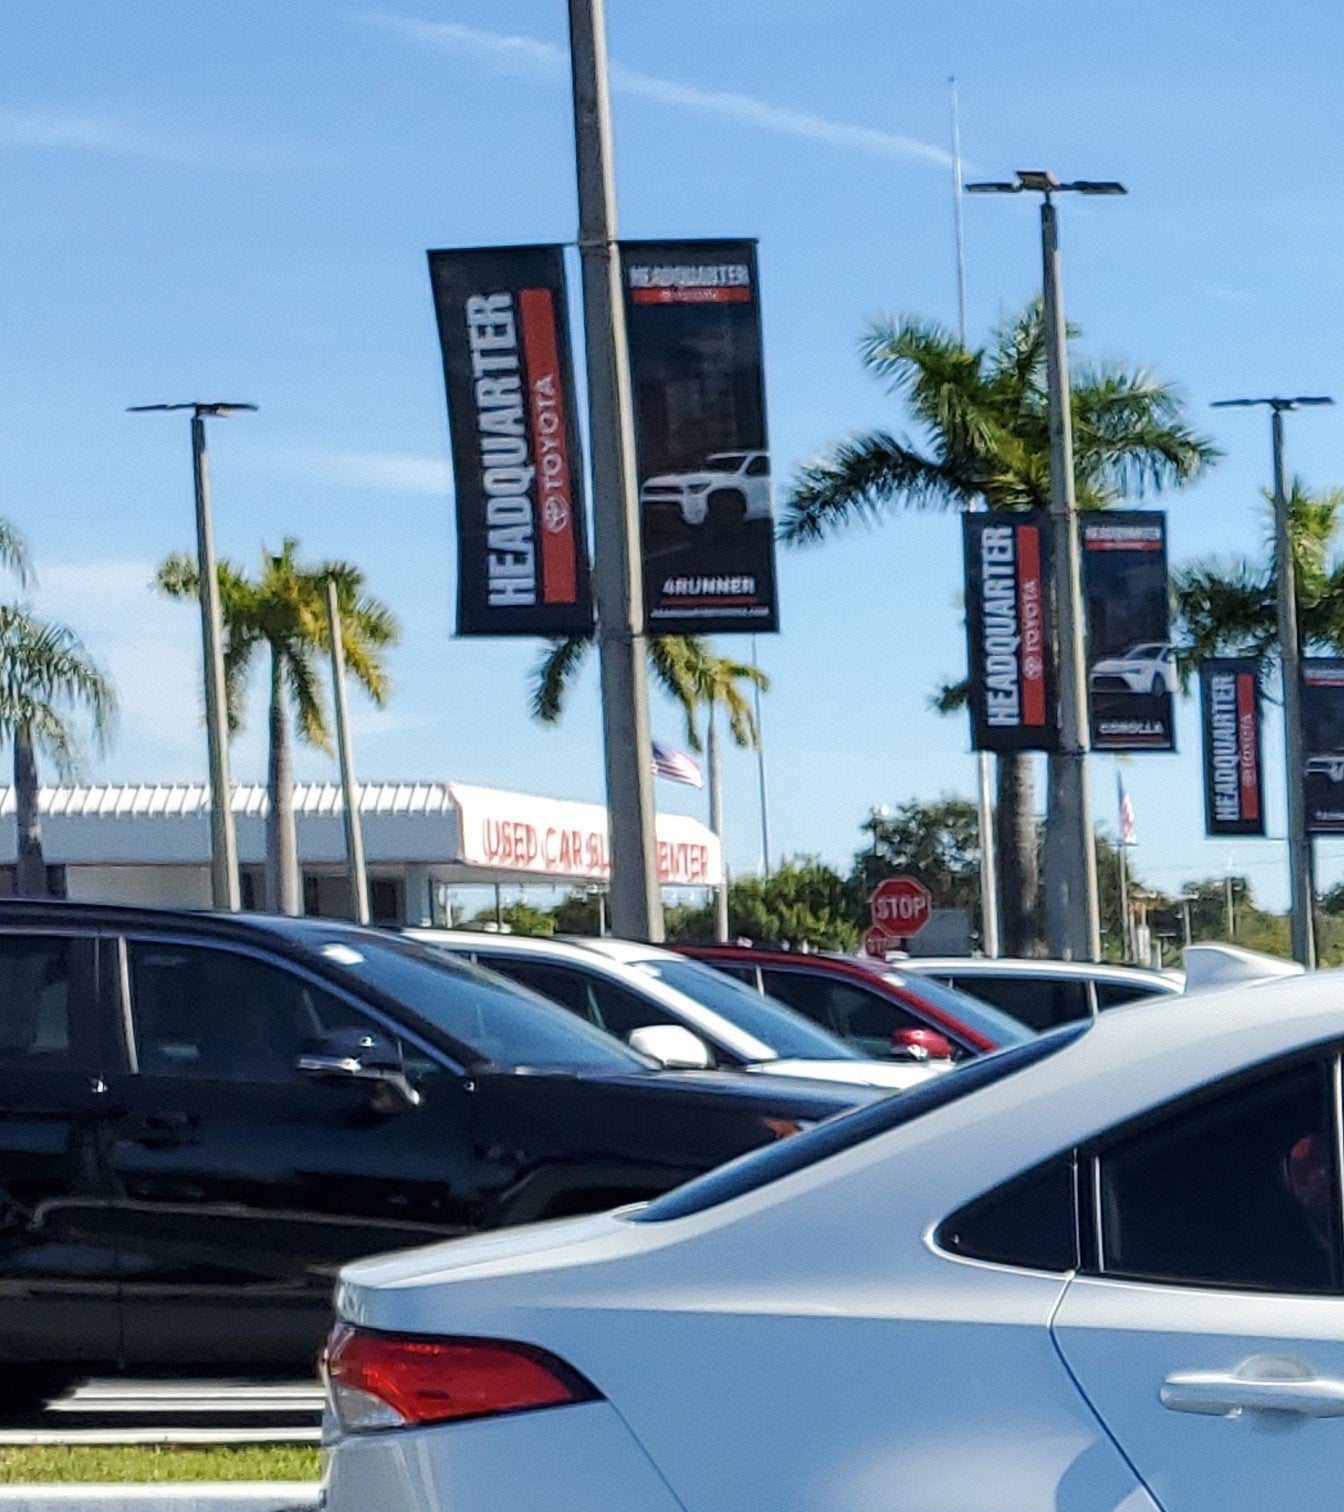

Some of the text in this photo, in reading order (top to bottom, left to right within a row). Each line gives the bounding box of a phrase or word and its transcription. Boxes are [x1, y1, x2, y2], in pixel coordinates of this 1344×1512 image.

[466, 291, 537, 606] HEADQUARTER
[534, 374, 565, 490] TOYOTA
[982, 525, 1021, 726] HEADQUARTER
[1022, 579, 1042, 652] TOYOTA
[1212, 675, 1240, 821] HEADQUARTER
[483, 818, 538, 861] USED
[543, 827, 582, 868] CAR
[876, 895, 926, 919] STOP
